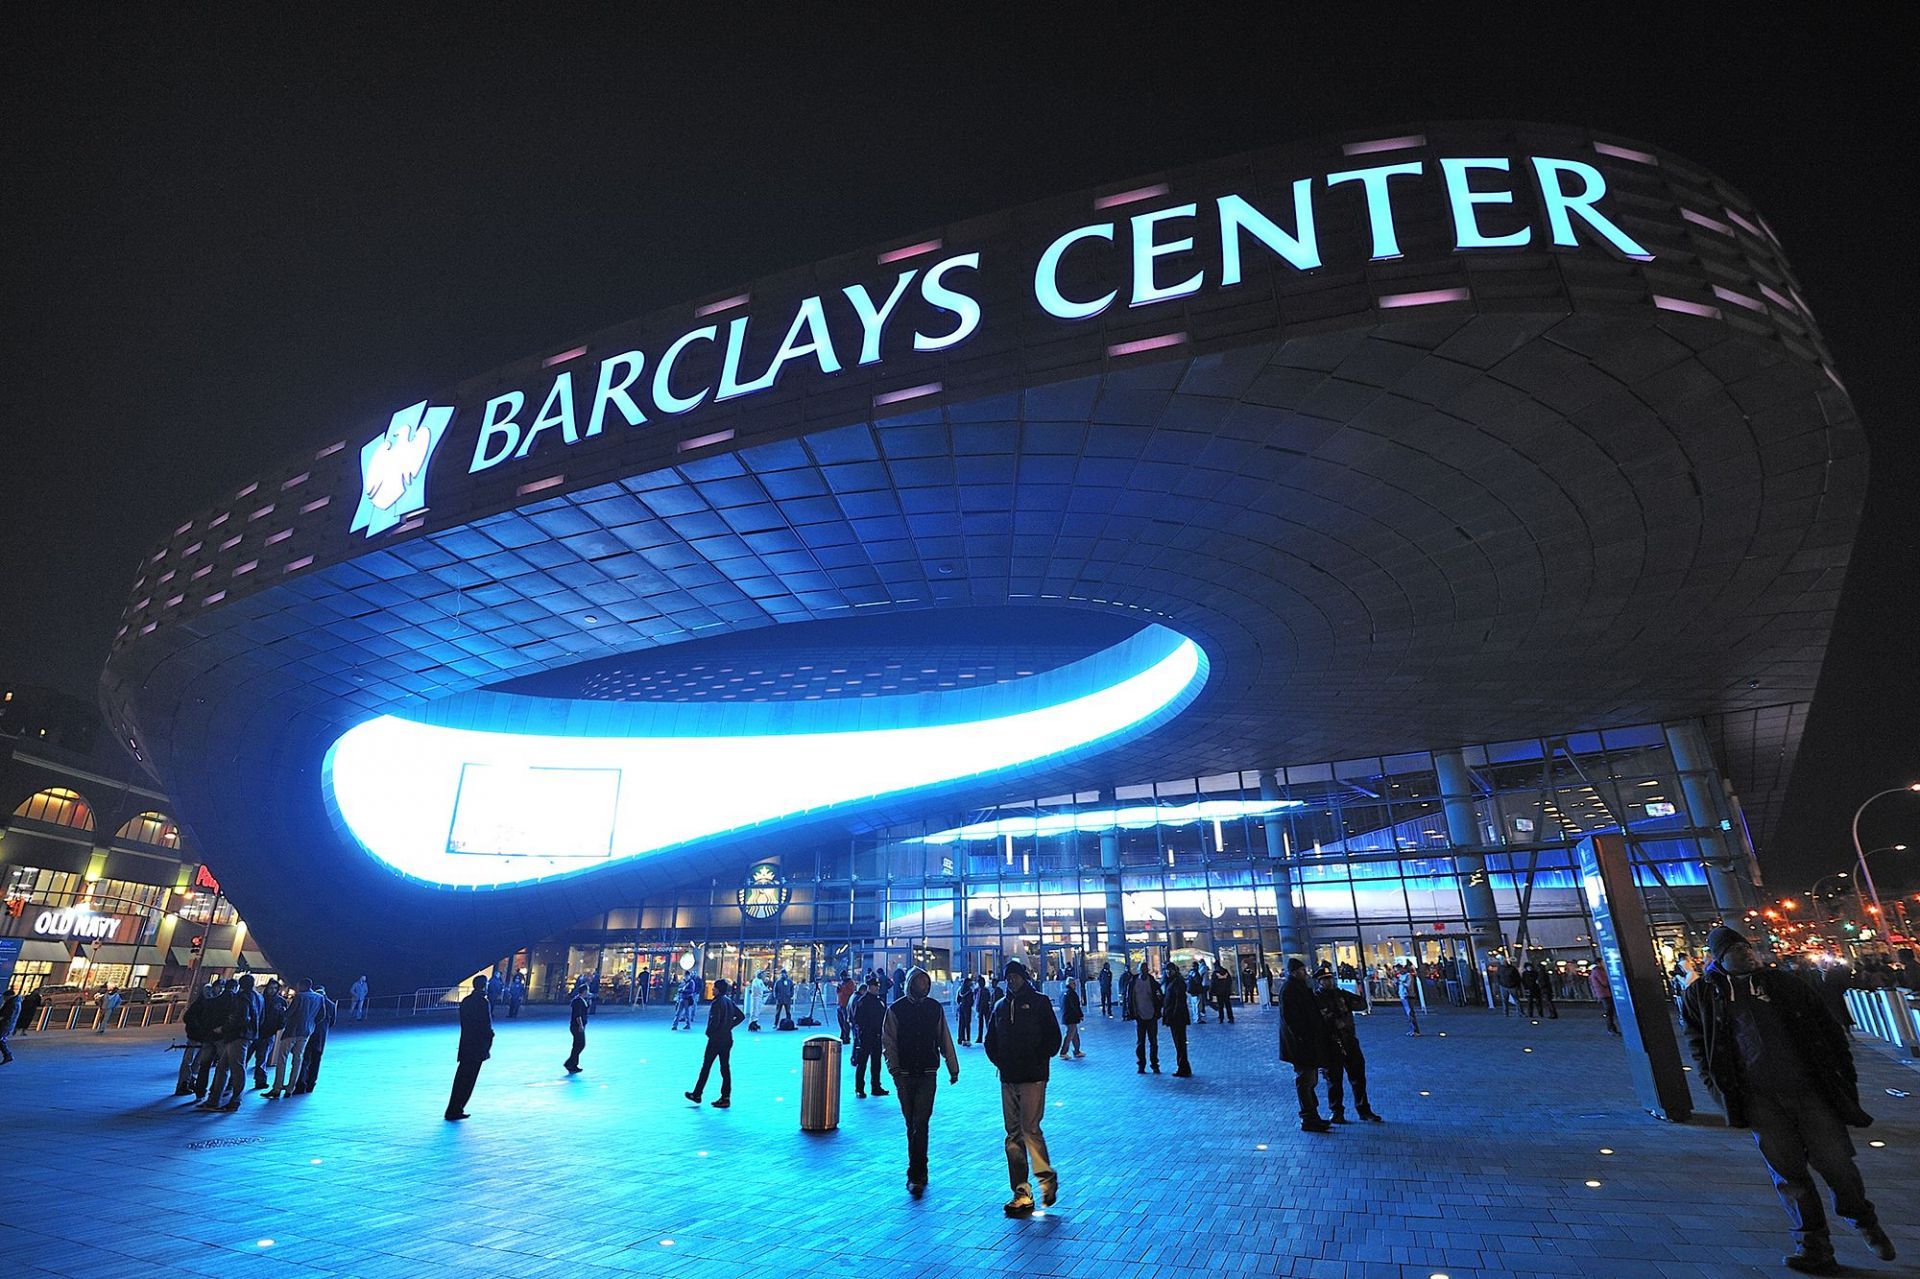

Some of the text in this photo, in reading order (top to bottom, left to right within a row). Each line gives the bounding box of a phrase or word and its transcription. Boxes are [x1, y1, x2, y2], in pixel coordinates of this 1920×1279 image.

[469, 156, 1655, 474] BARCLAYS CENTER
[34, 907, 121, 938] OLD NAVY
